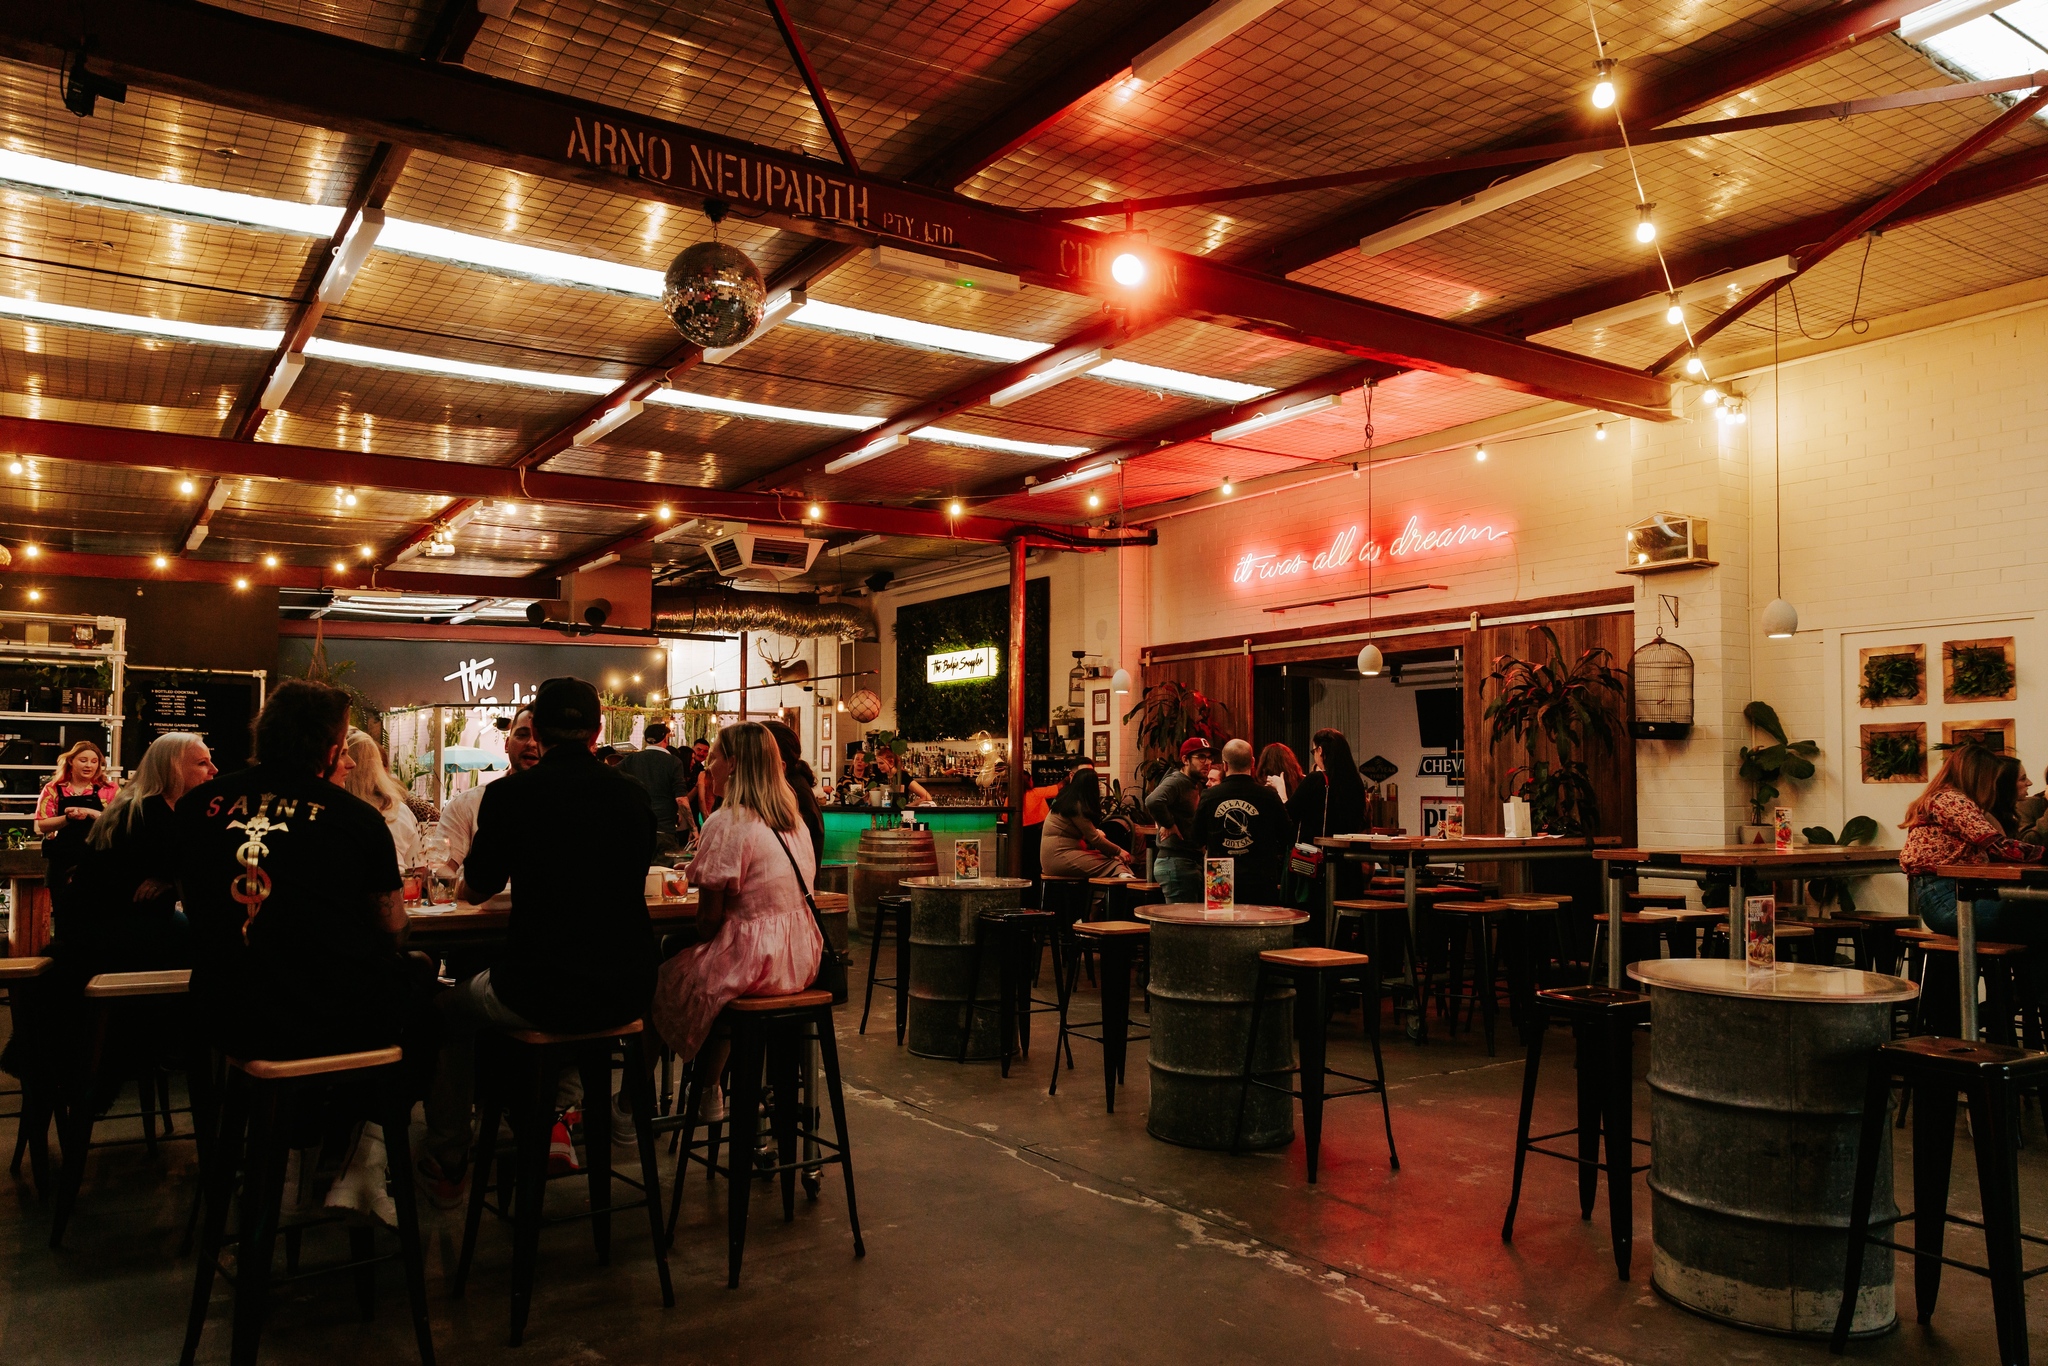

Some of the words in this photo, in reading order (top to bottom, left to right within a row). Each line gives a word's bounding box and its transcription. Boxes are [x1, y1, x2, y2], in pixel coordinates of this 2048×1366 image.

[567, 116, 672, 181] ARNO
[690, 144, 869, 228] NEUPARTH
[924, 221, 953, 245] LTD
[1233, 552, 1276, 583] it
[1255, 554, 1307, 579] was
[1312, 525, 1357, 570] all
[1359, 541, 1380, 562] a
[1389, 515, 1509, 556] dream
[1422, 758, 1464, 774] CHEV
[206, 791, 326, 821] SAINT
[1216, 800, 1258, 816] VILLAINS
